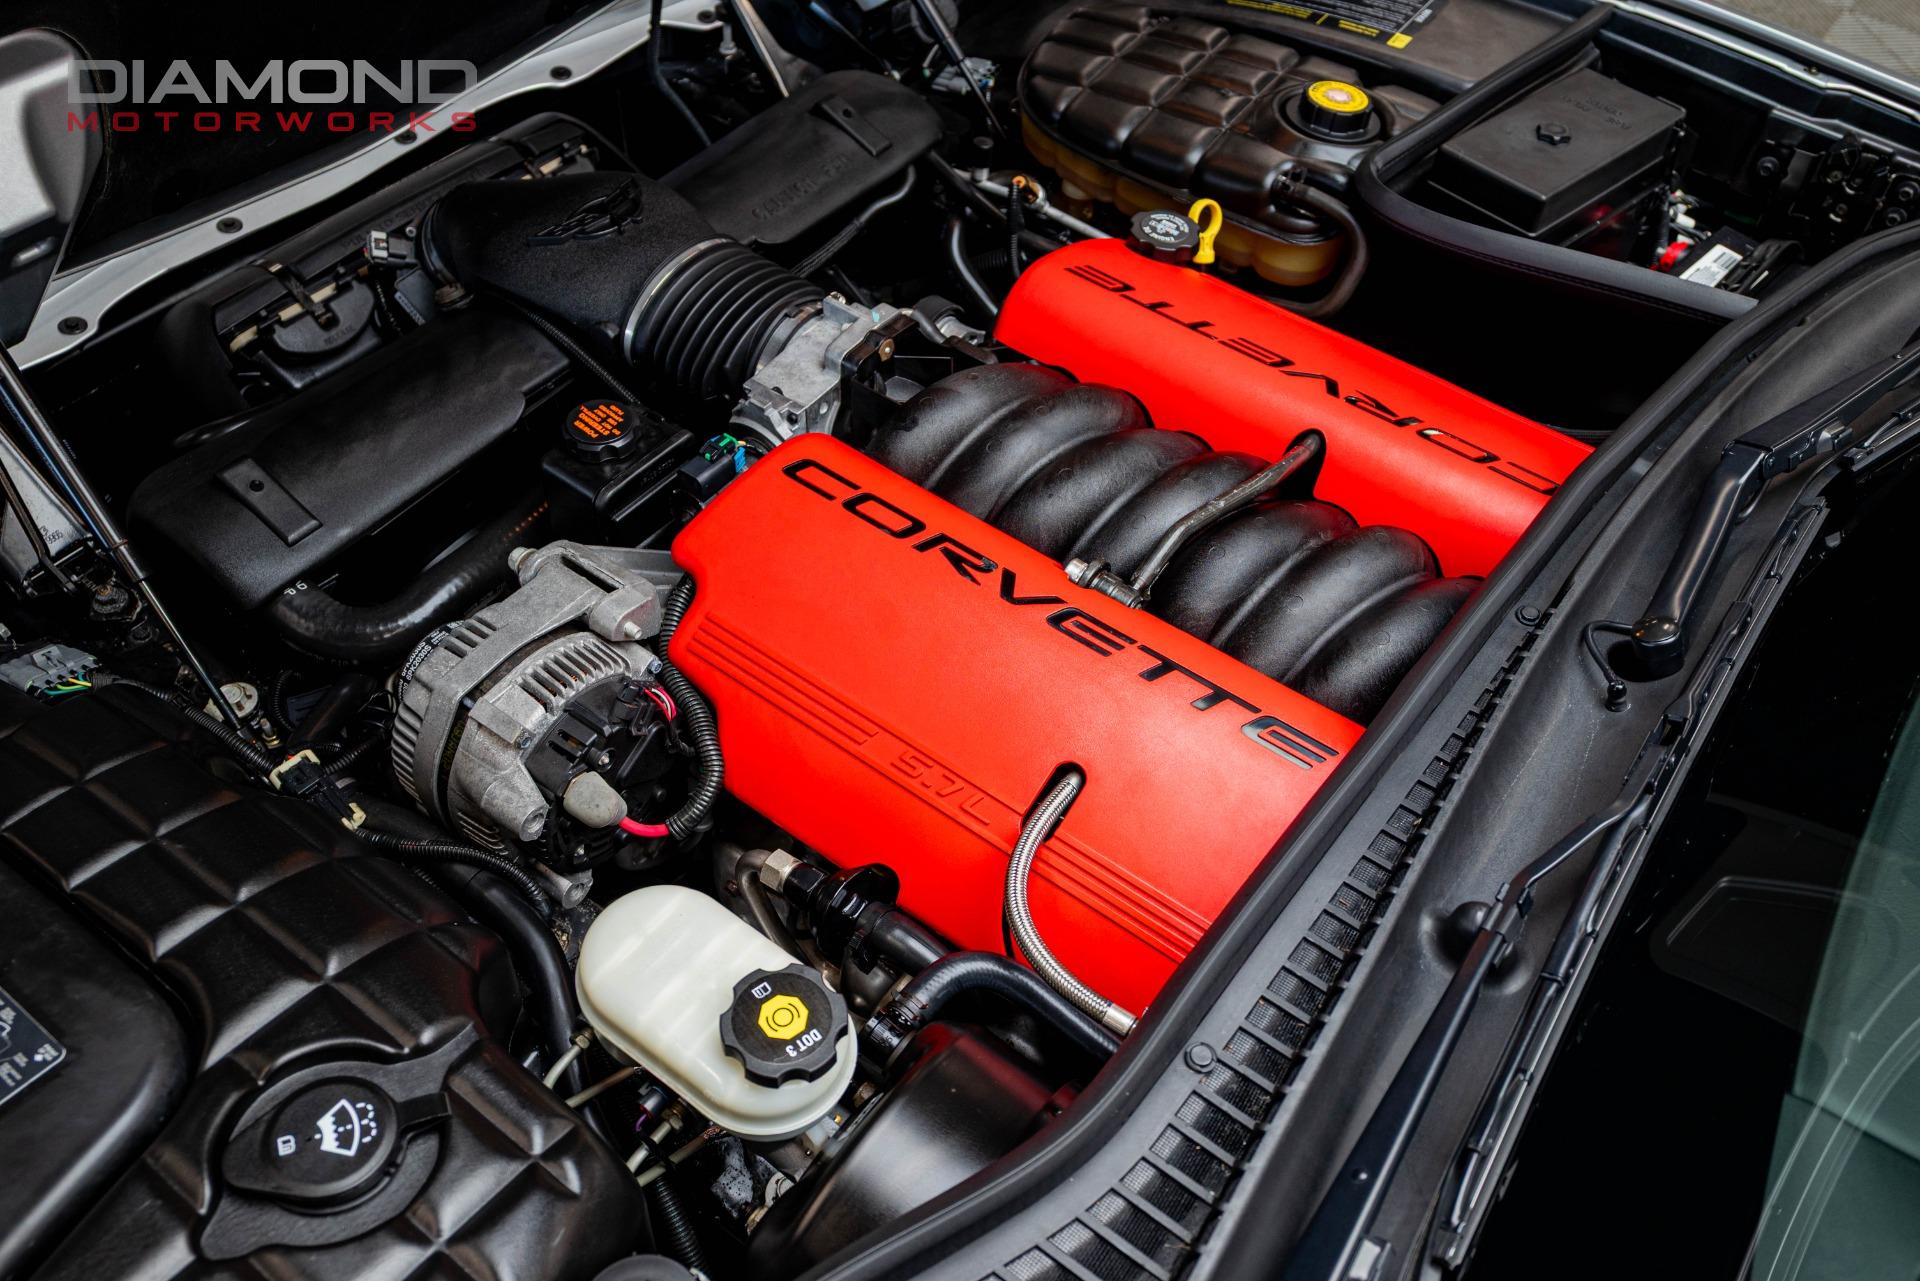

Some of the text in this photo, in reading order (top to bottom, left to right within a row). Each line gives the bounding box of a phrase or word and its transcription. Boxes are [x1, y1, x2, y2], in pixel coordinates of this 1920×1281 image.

[1064, 265, 1560, 496] CORVETTE
[574, 420, 599, 438] POWER
[578, 412, 611, 436] STEERING
[782, 458, 1340, 770] CORVETTE
[889, 750, 992, 826] 5.7L
[785, 1028, 823, 1058] DOT 3
